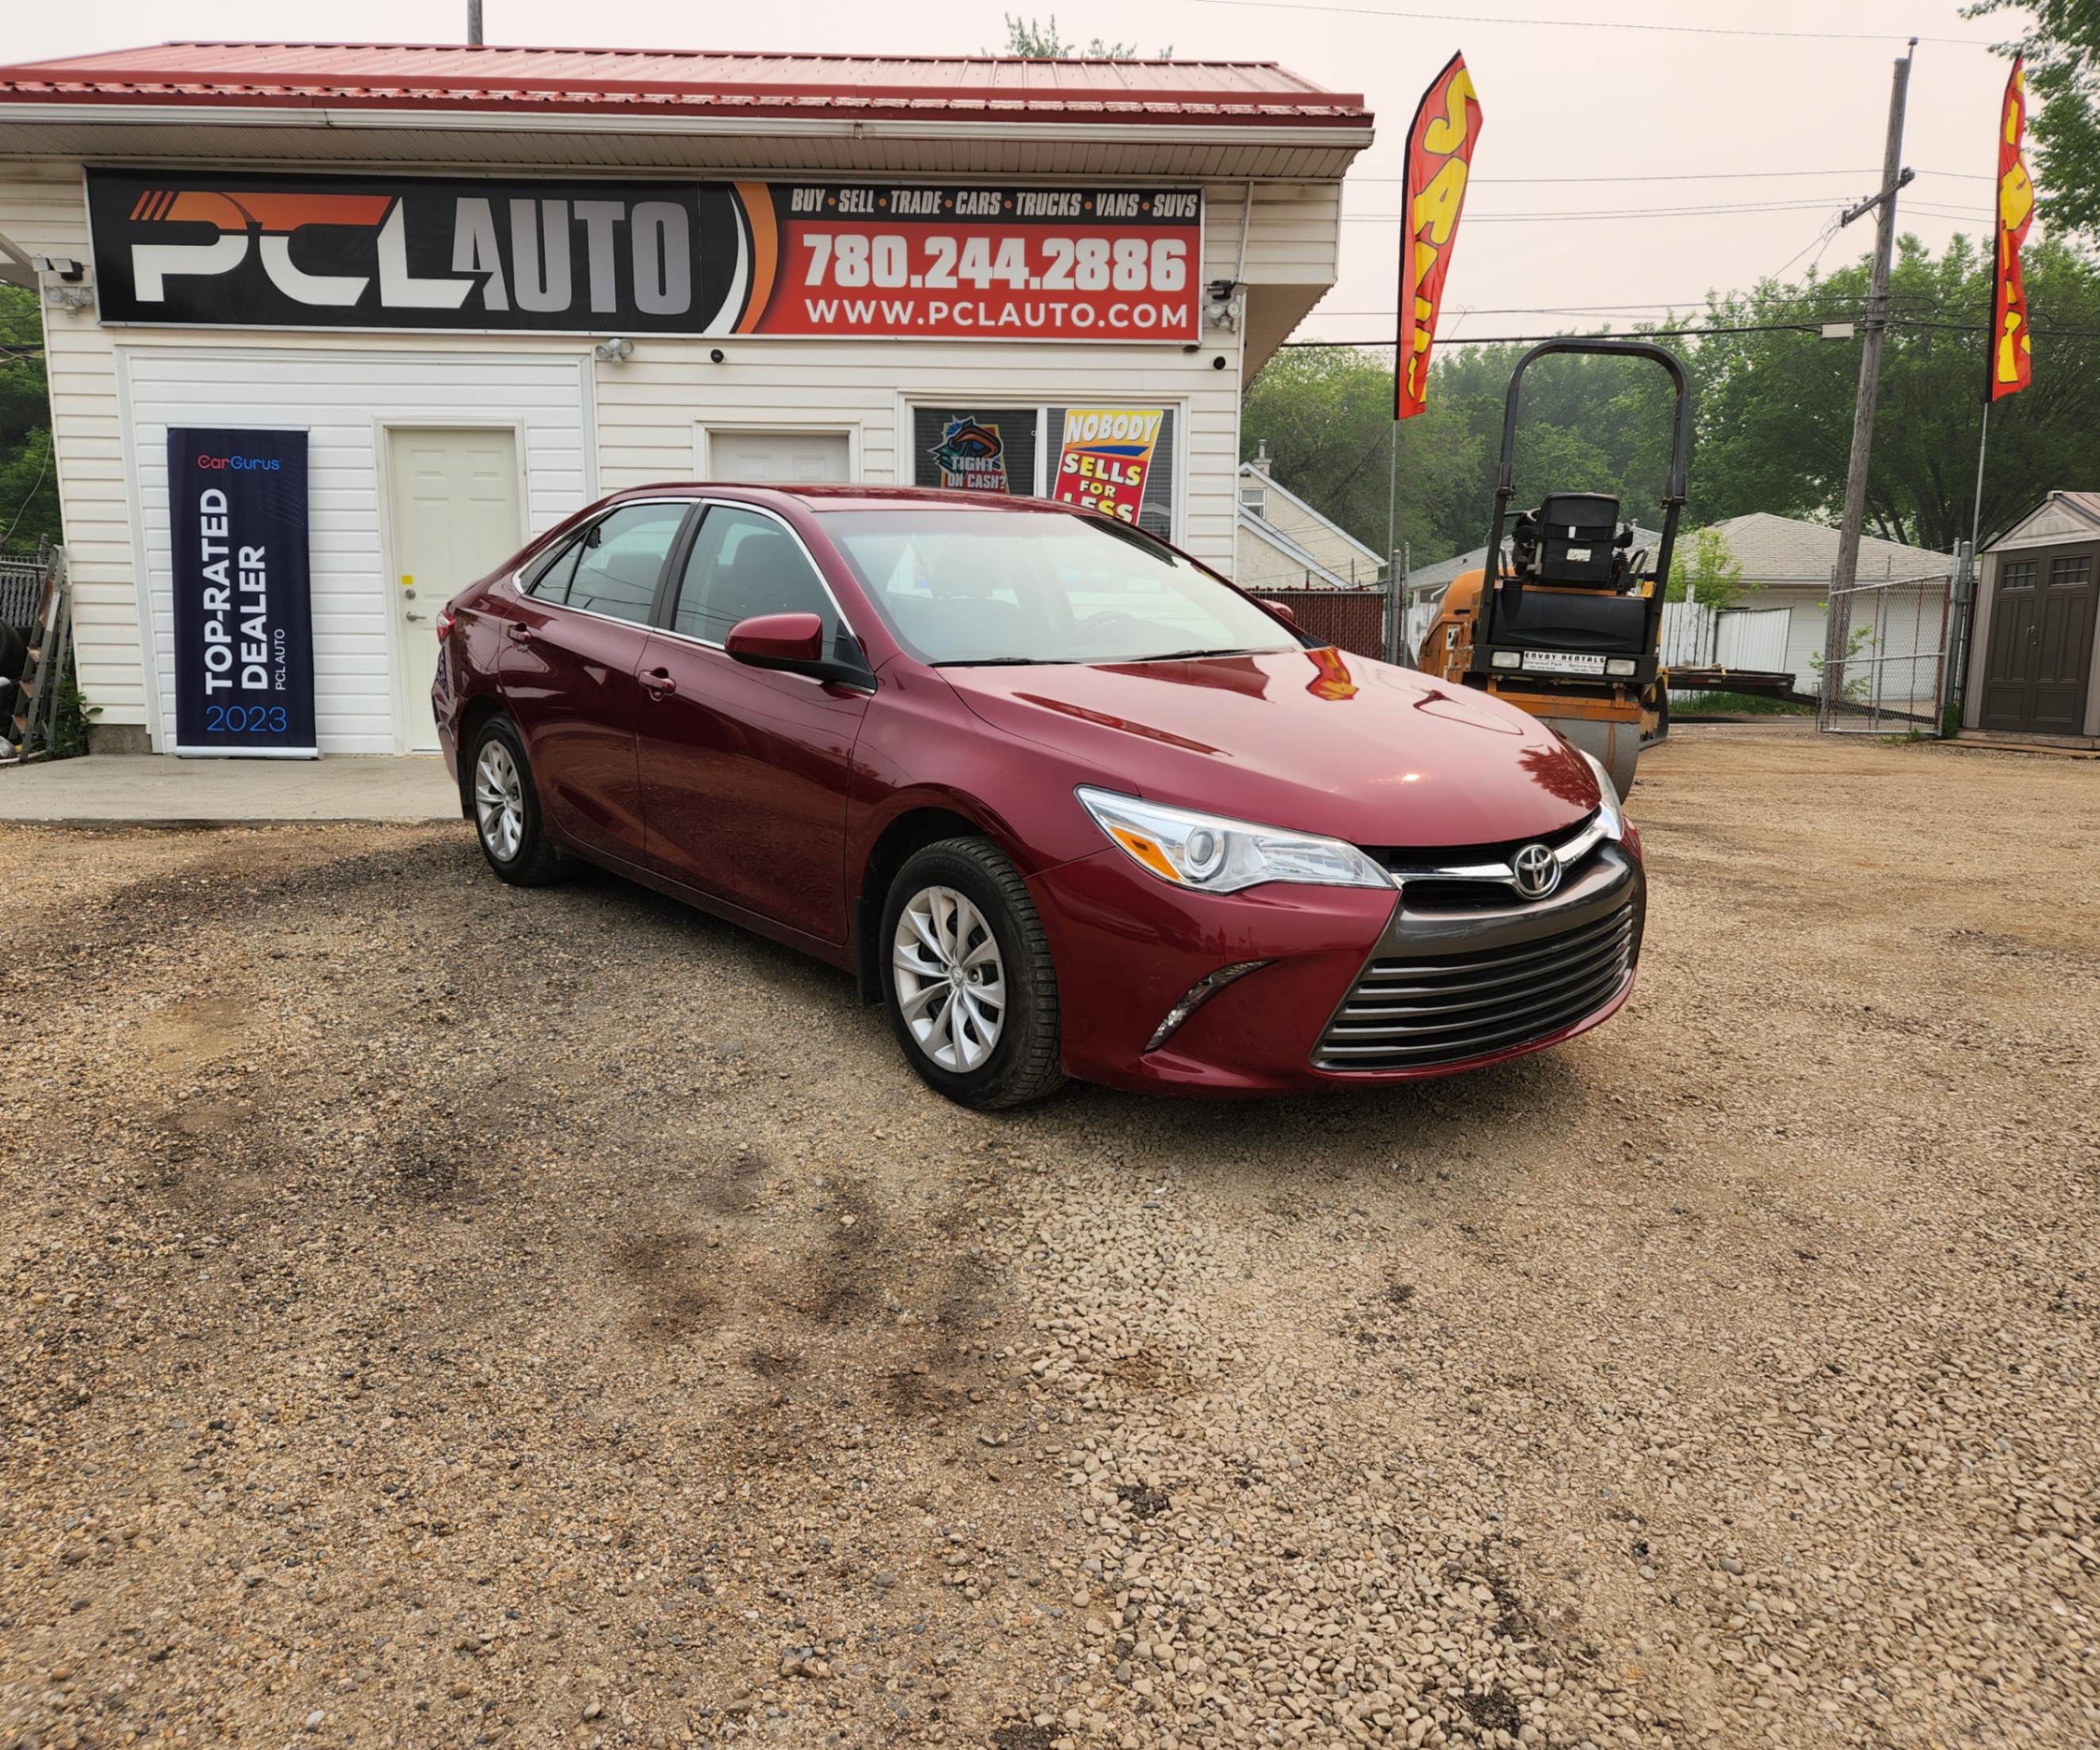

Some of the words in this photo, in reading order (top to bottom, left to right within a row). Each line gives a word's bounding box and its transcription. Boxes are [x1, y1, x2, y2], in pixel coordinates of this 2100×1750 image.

[791, 188, 825, 211] BUY
[838, 189, 874, 213] SELL
[890, 191, 943, 214] TRADE
[955, 191, 1002, 215] CARS
[1015, 192, 1082, 216] TRUCKS
[1095, 193, 1140, 217] VANS
[1152, 194, 1198, 217] SUVS
[803, 234, 1187, 292] 780.244.2886
[805, 299, 1188, 328] WWW.PCLAUTO.COM
[1065, 413, 1160, 444] NOBODY
[197, 454, 280, 470] CarGurus
[951, 456, 994, 471] TIGHT
[1062, 453, 1143, 486] SELLS
[947, 473, 963, 488] ON
[967, 473, 1006, 489] CASH?
[1079, 480, 1116, 498] FOR
[199, 488, 233, 695] TOP-RATED
[238, 545, 268, 690] DEALER
[274, 628, 285, 663] AUTO
[275, 664, 286, 690] PCL
[206, 705, 288, 732] 2023
